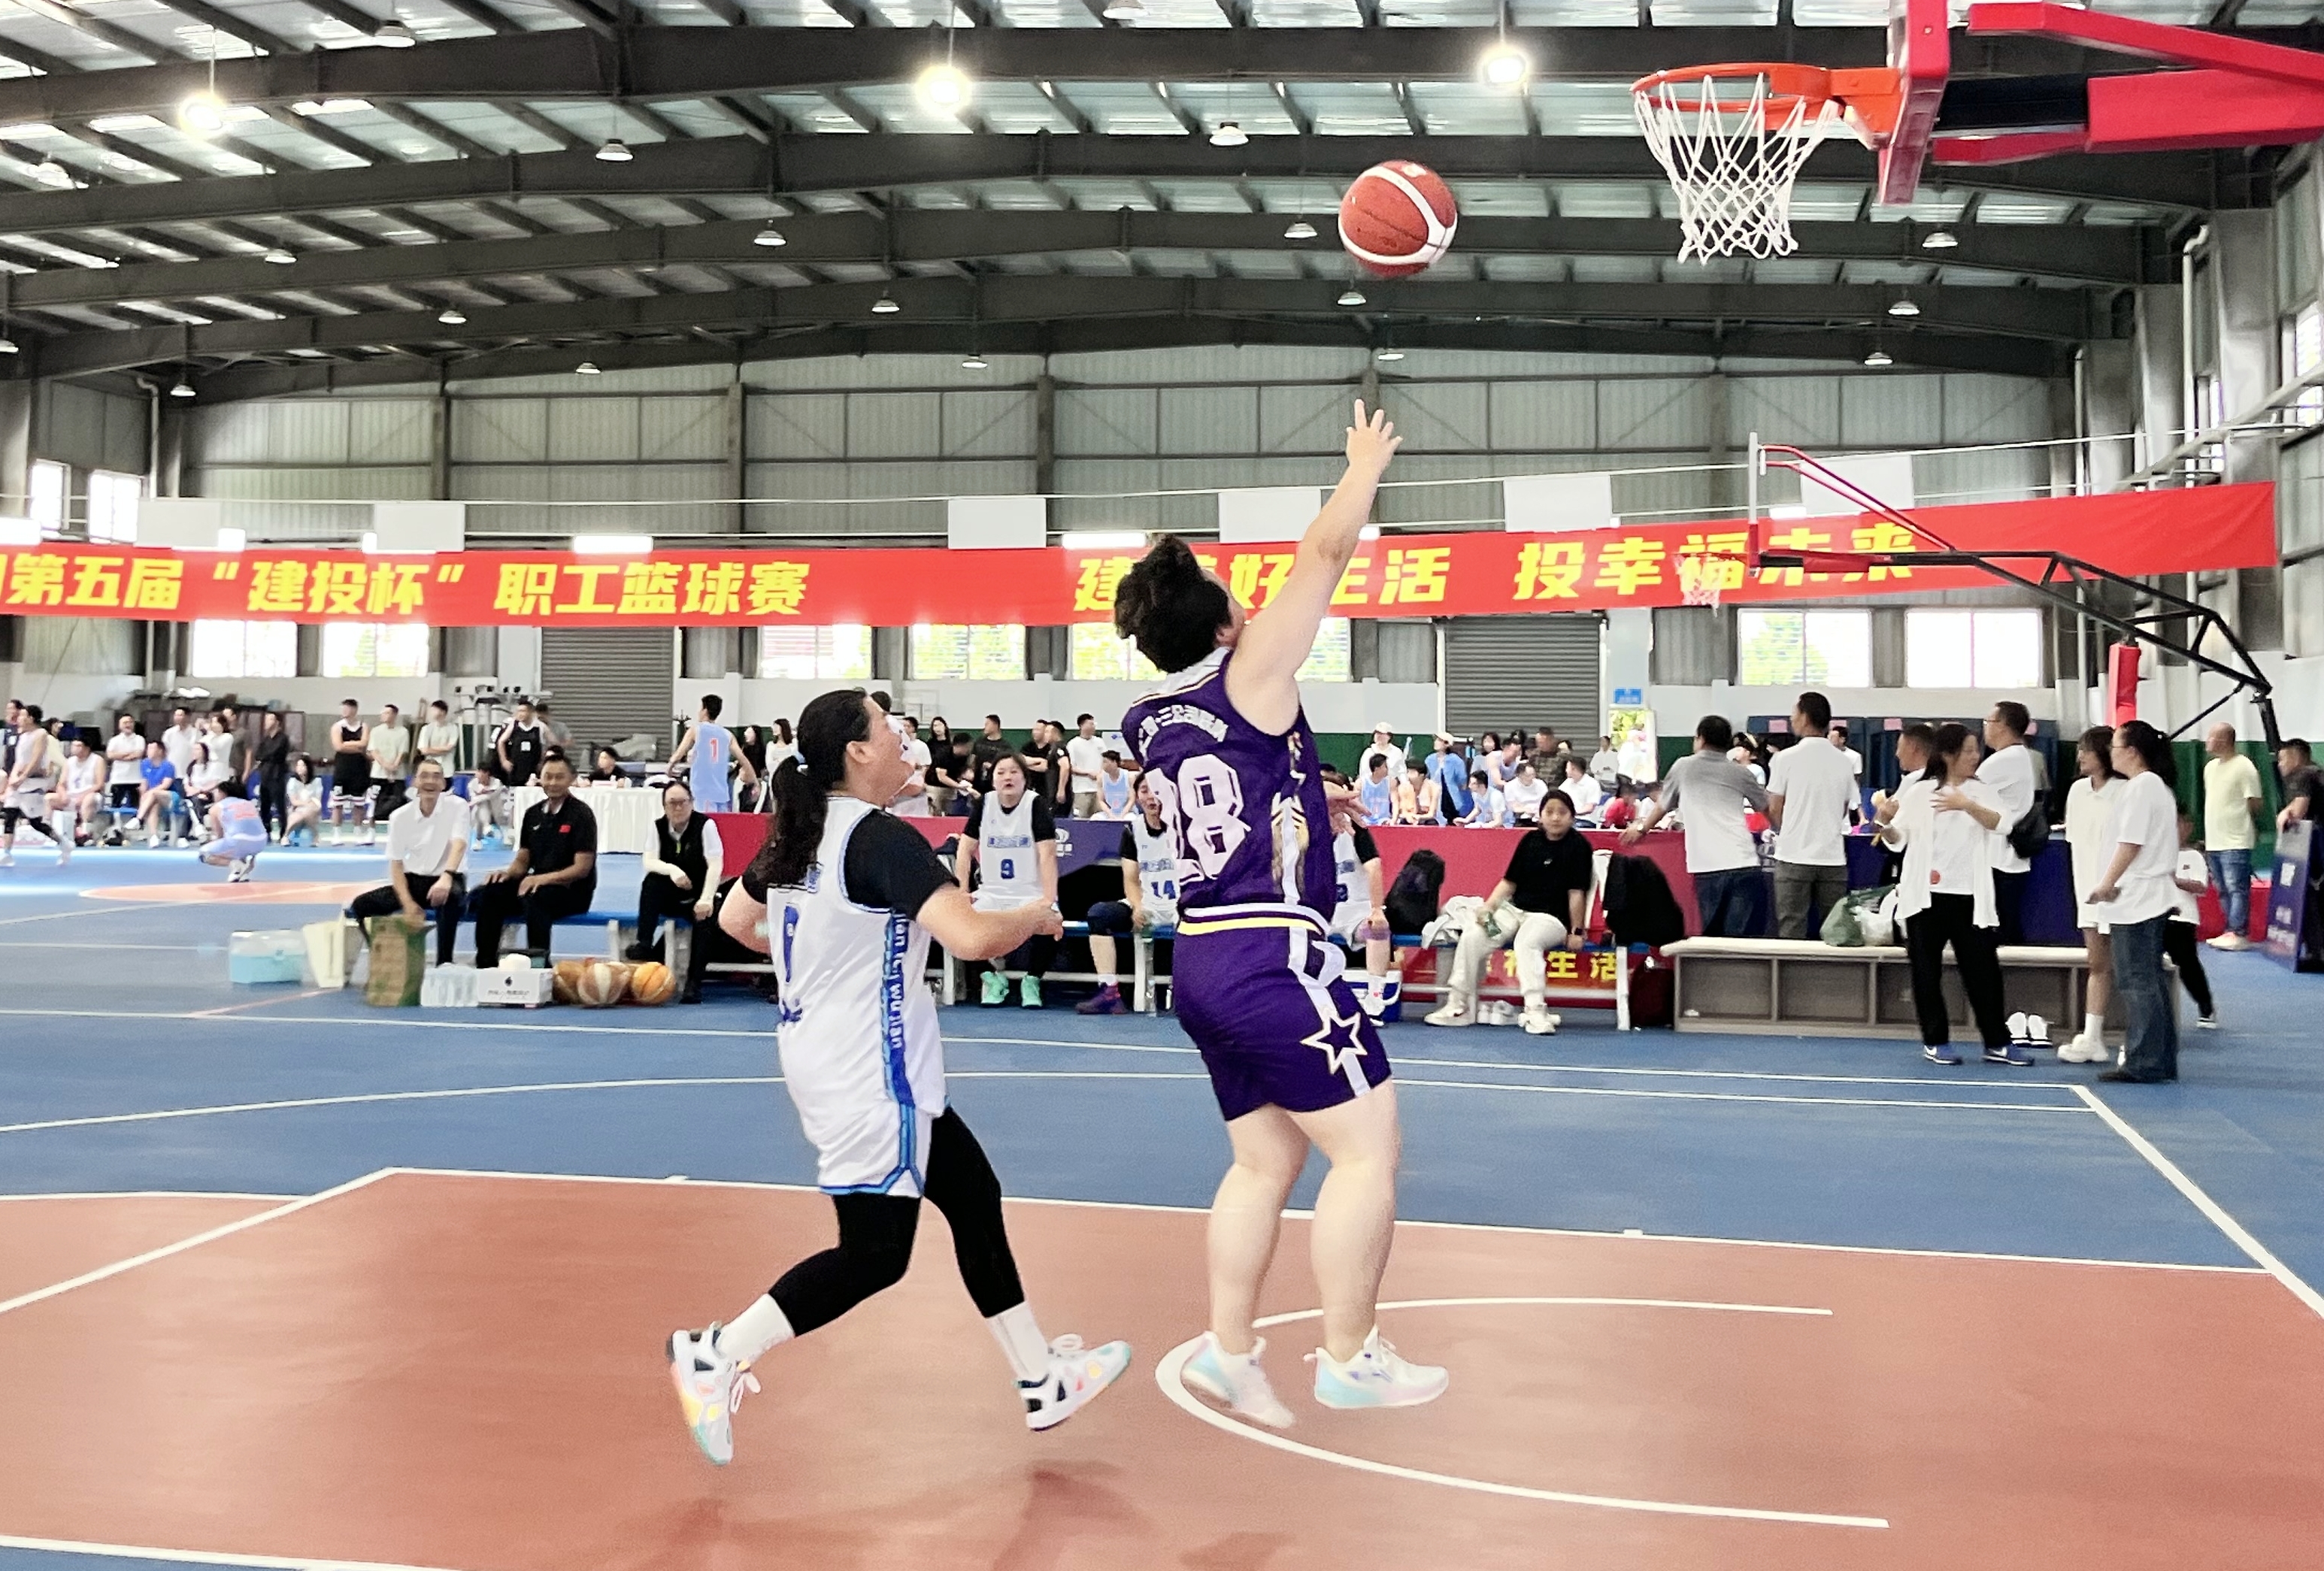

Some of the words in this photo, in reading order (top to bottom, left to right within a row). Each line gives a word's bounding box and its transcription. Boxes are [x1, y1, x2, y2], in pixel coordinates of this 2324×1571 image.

[1073, 546, 1452, 612] 建好生活
[709, 737, 720, 764] 1
[1001, 858, 1015, 879] 9
[1150, 879, 1176, 901] 14
